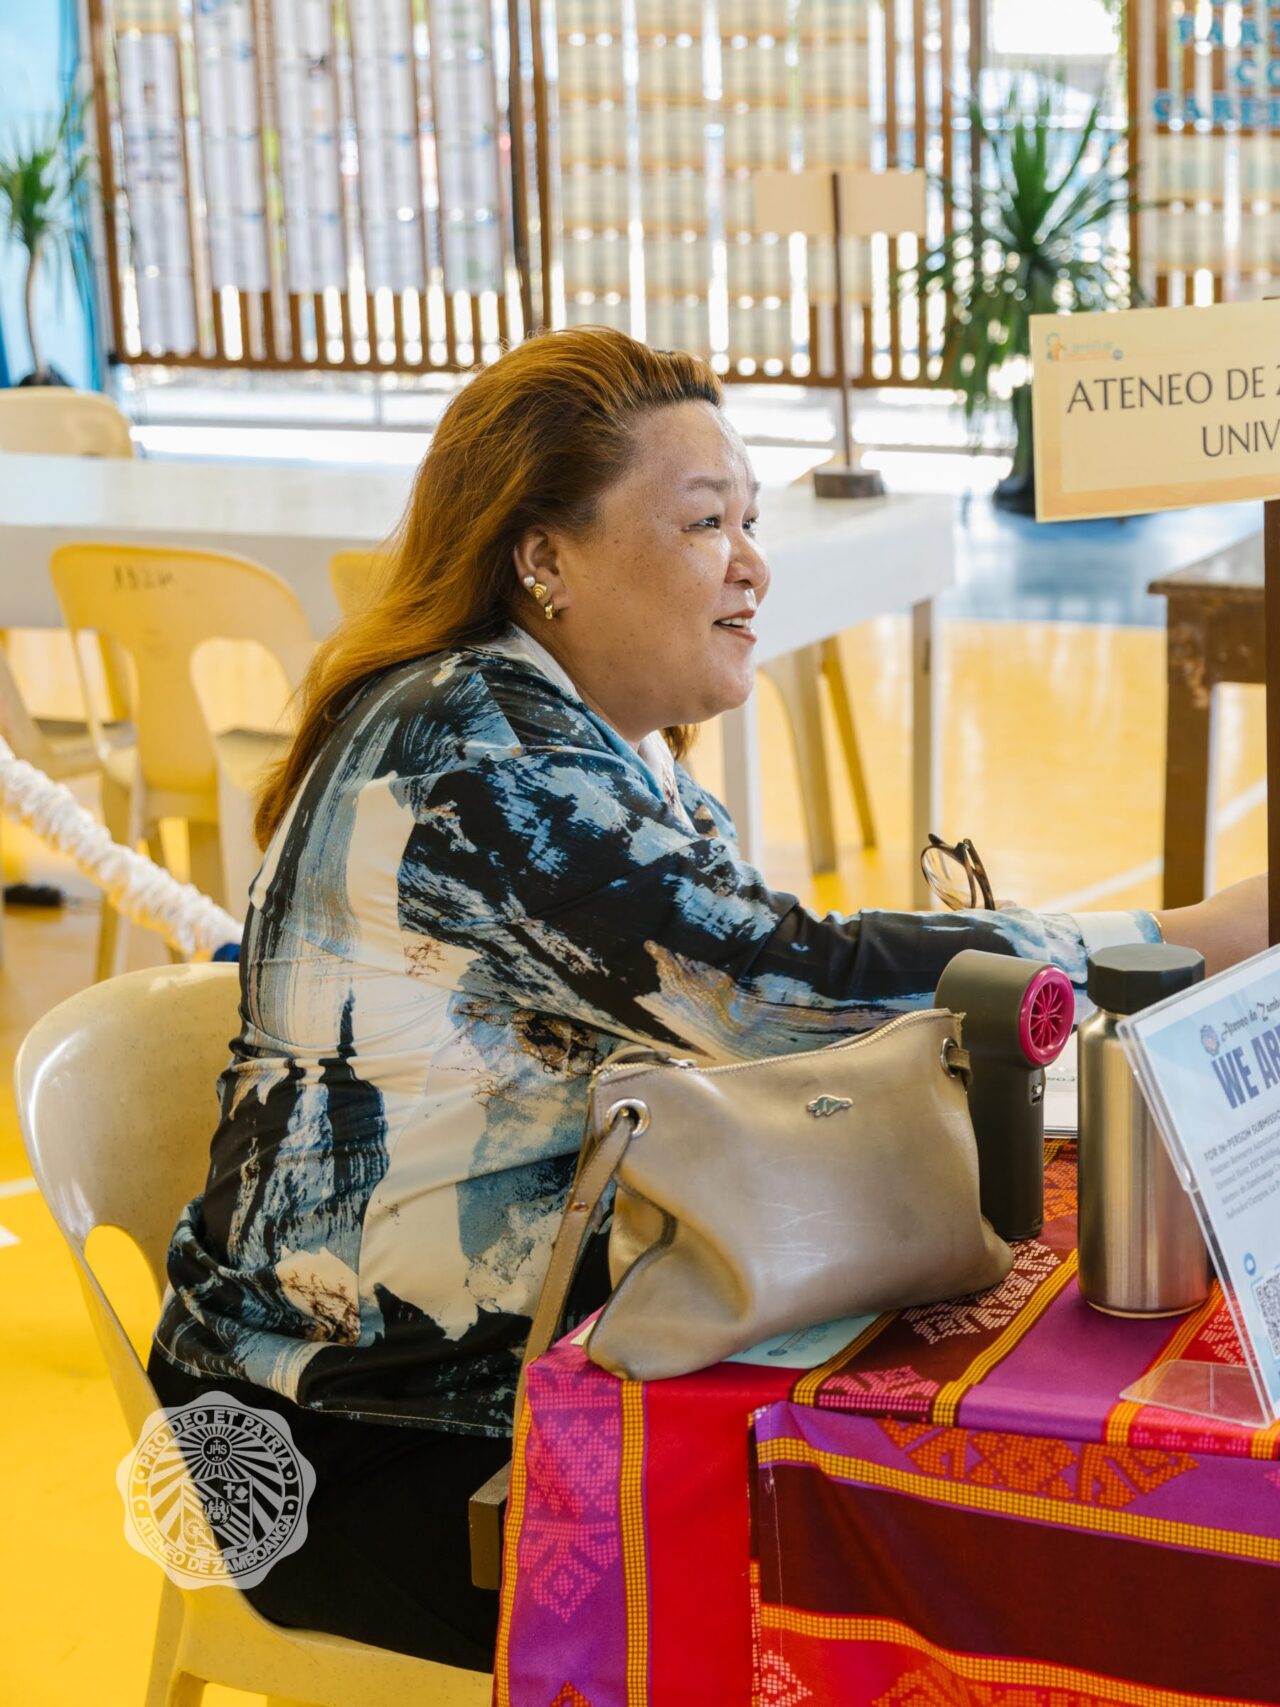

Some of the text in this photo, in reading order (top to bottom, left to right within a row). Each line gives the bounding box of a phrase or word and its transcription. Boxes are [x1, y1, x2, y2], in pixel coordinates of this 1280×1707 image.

[1066, 371, 1213, 413] ATENEO
[1226, 366, 1265, 401] DE
[1211, 1047, 1260, 1110] WE
